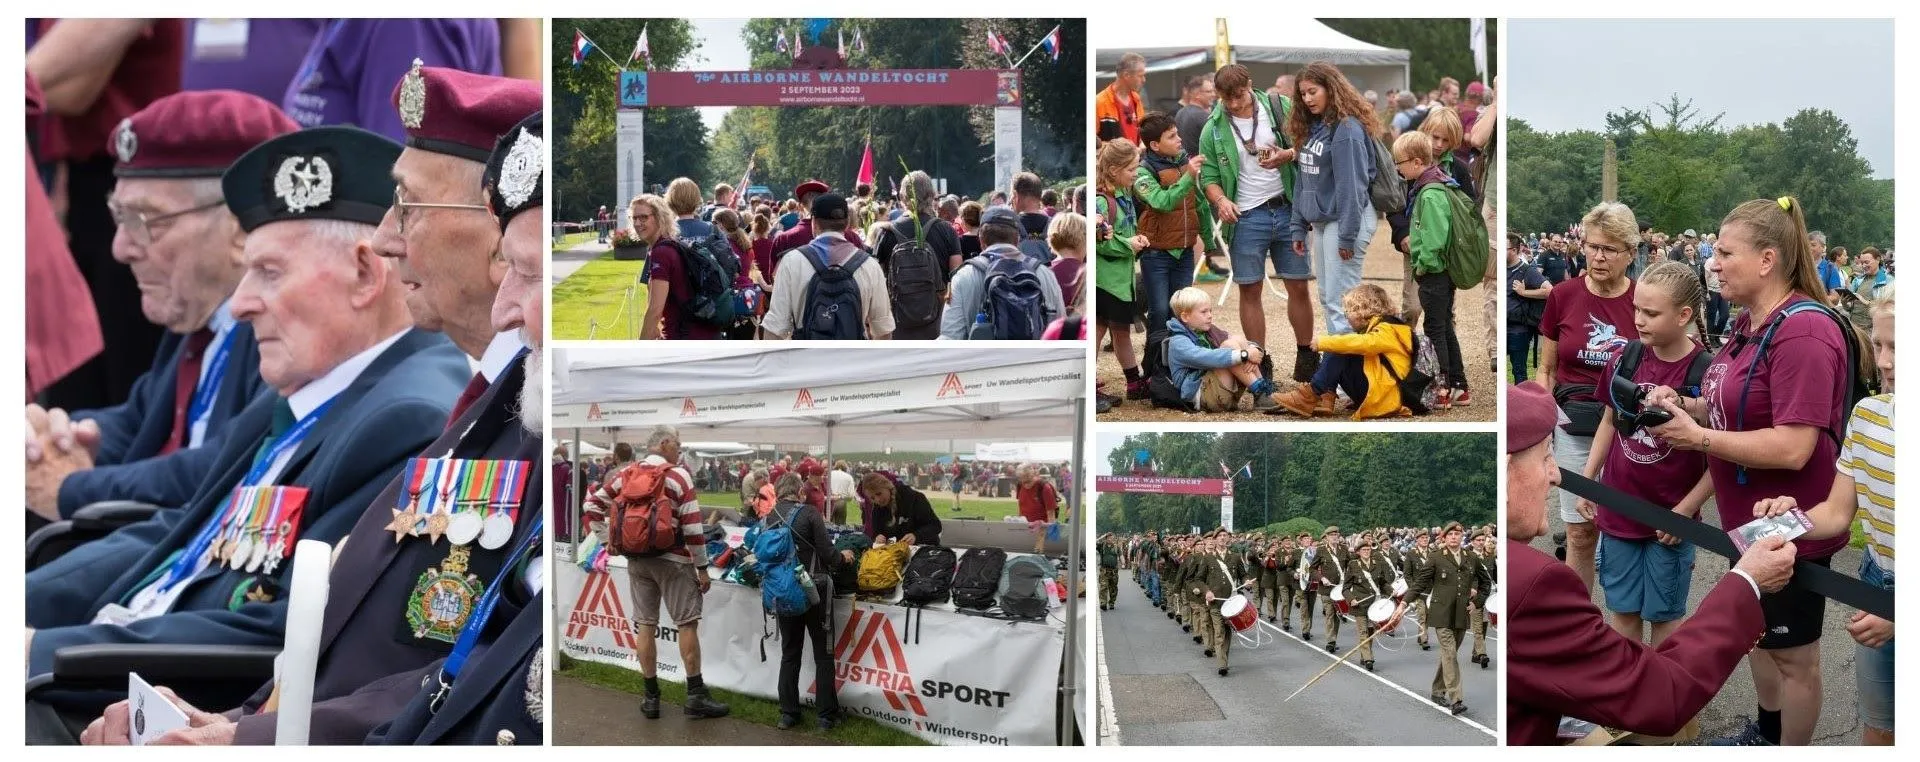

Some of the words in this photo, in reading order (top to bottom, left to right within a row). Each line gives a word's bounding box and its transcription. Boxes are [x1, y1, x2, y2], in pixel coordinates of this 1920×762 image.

[720, 72, 811, 83] AIRBORNE
[819, 72, 950, 84] WANDELTOCHT
[781, 86, 787, 94] 2
[788, 86, 838, 94] SEPTEMBER
[999, 372, 1082, 387] Wandelsportspecialist
[1622, 439, 1662, 462] OOSTERBEEK
[1097, 476, 1141, 484] AIRBORNE
[569, 611, 633, 634] AUSTRIA
[597, 646, 629, 660] Outdoor
[834, 660, 916, 694] USTRIA
[920, 679, 1011, 709] SPORT
[861, 706, 913, 726] Outdoor
[924, 720, 1010, 746] Wintersport
